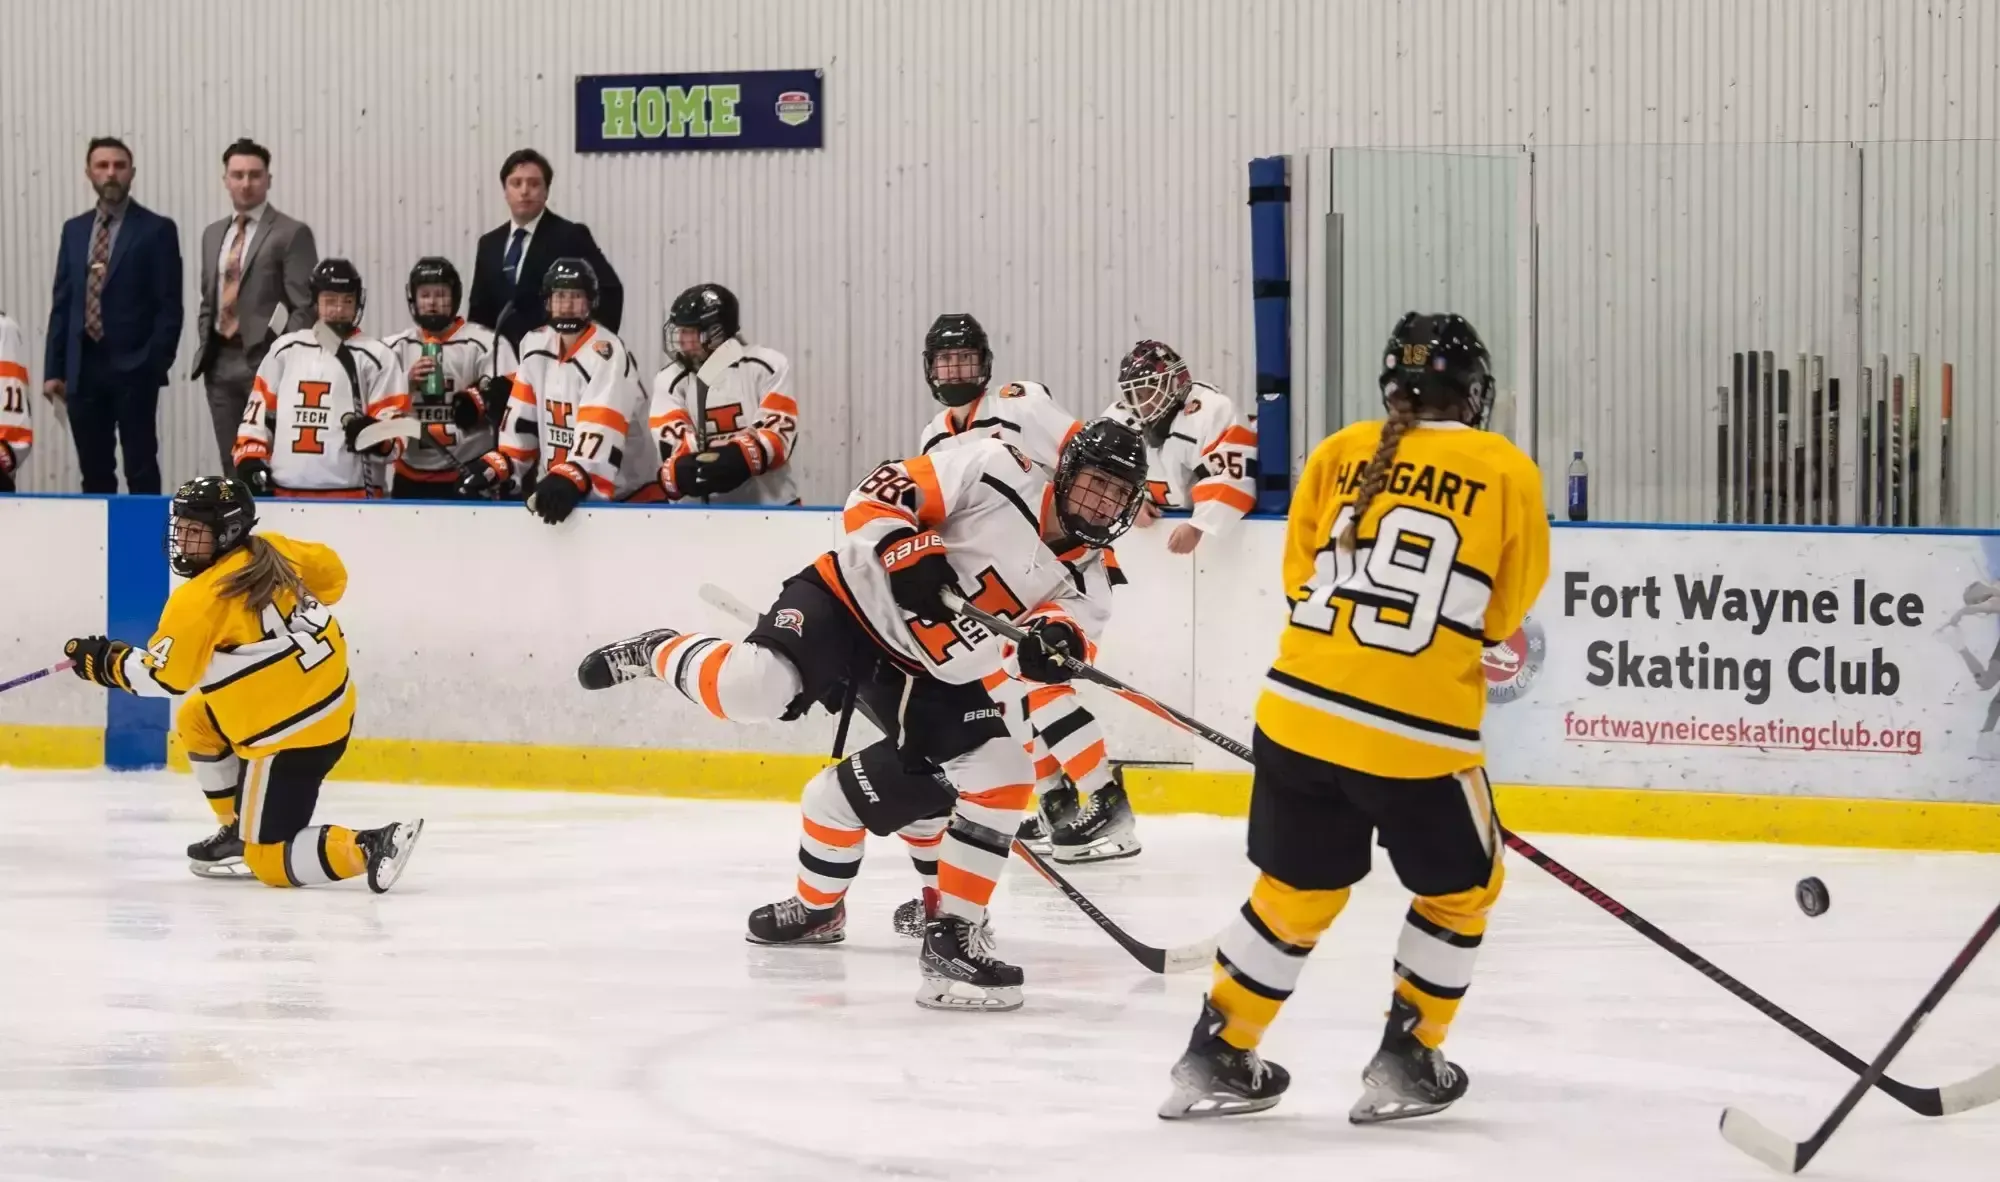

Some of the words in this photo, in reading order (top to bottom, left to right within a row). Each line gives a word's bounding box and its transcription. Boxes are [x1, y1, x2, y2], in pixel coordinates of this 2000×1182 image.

[601, 84, 741, 139] HOME
[3, 386, 24, 413] 11
[296, 411, 328, 424] TECH
[550, 429, 574, 446] TECH
[574, 431, 604, 460] 17
[1208, 451, 1243, 480] 35
[859, 466, 916, 506] 88
[883, 534, 946, 568] BAUE
[1290, 502, 1463, 657] 19
[1564, 571, 1661, 619] Fort
[1673, 573, 1839, 636] Wayne
[1853, 578, 1925, 627] Ice
[1586, 639, 1772, 705] Skating
[1787, 645, 1901, 697] Club
[963, 708, 1002, 723] BAUE
[1209, 732, 1253, 758] FLYLITE
[1564, 711, 1922, 756] fortwayneiceskatingclub.org
[1068, 891, 1110, 926] FLYLITE
